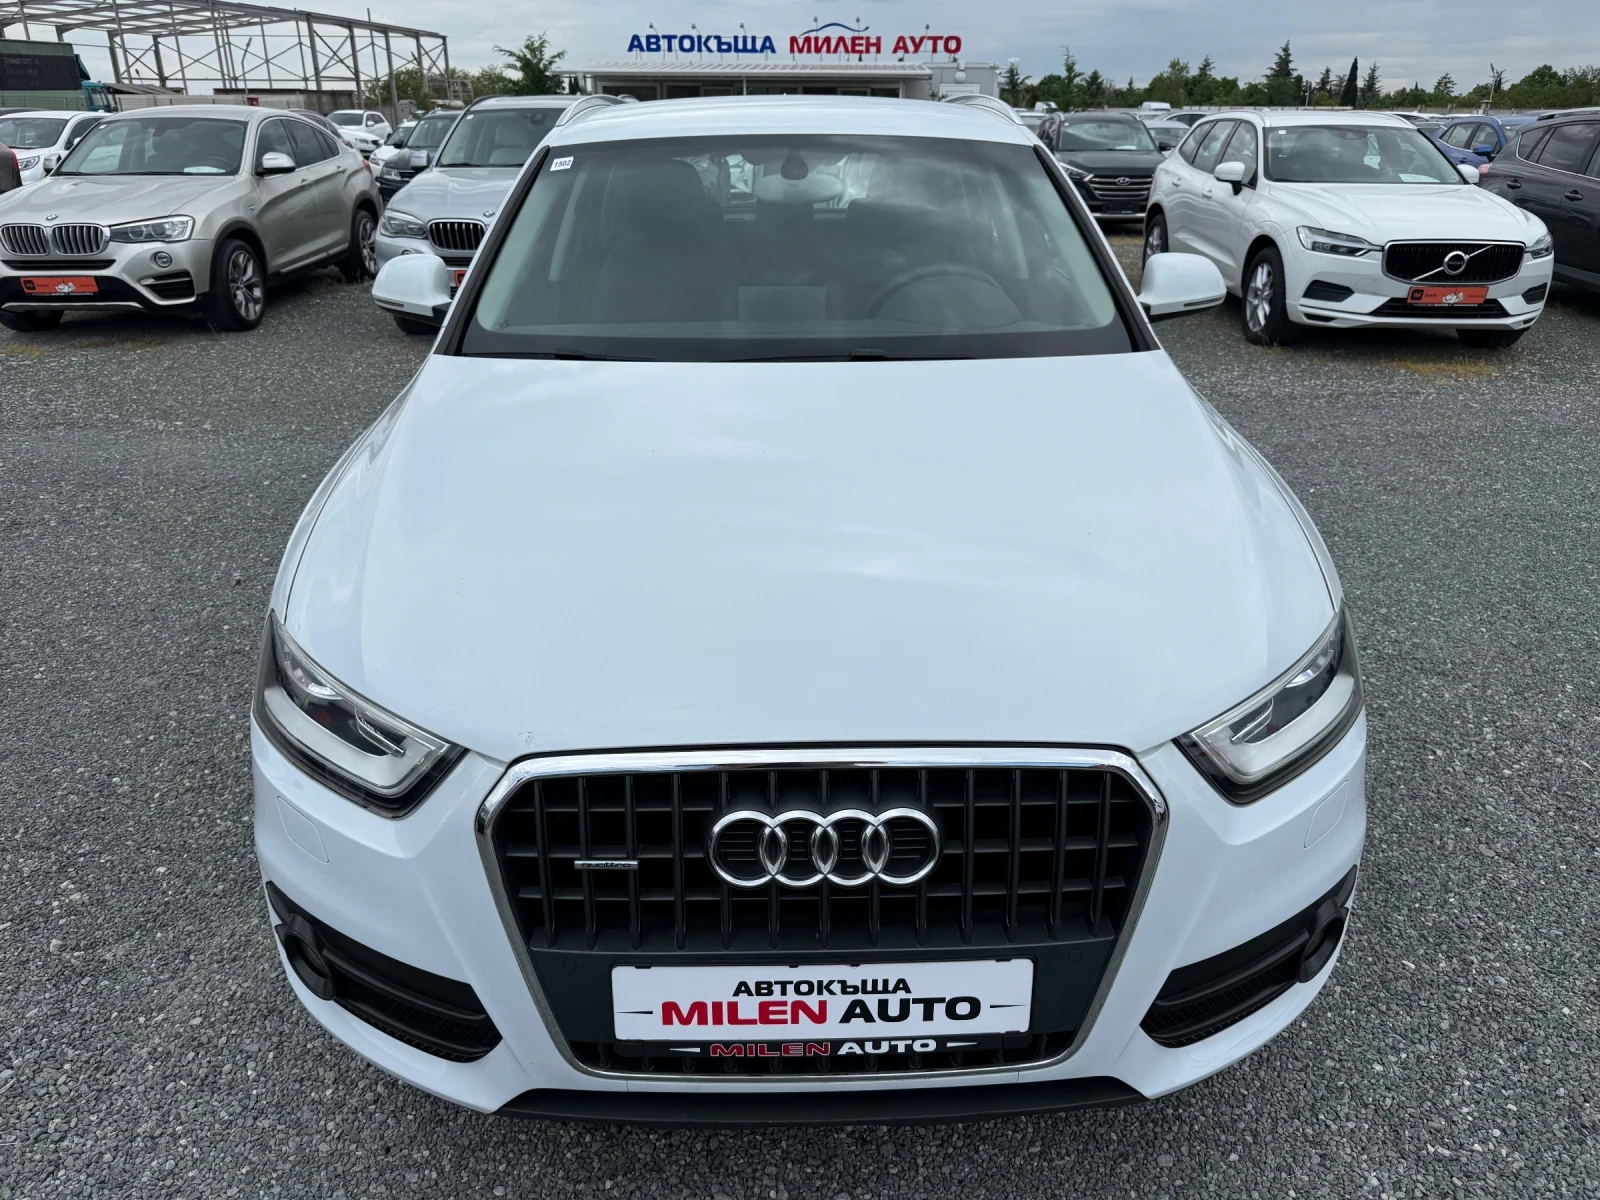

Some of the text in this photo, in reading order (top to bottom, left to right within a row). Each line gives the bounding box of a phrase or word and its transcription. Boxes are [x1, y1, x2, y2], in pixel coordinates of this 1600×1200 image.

[627, 34, 962, 55] АВТОКЪЩА МИЛЕН АУТО
[554, 160, 572, 168] 1502
[732, 978, 912, 997] АВТОКЪЩА
[661, 996, 982, 1026] MILEN AUTO
[709, 1038, 937, 1057] MILEN AUTO
